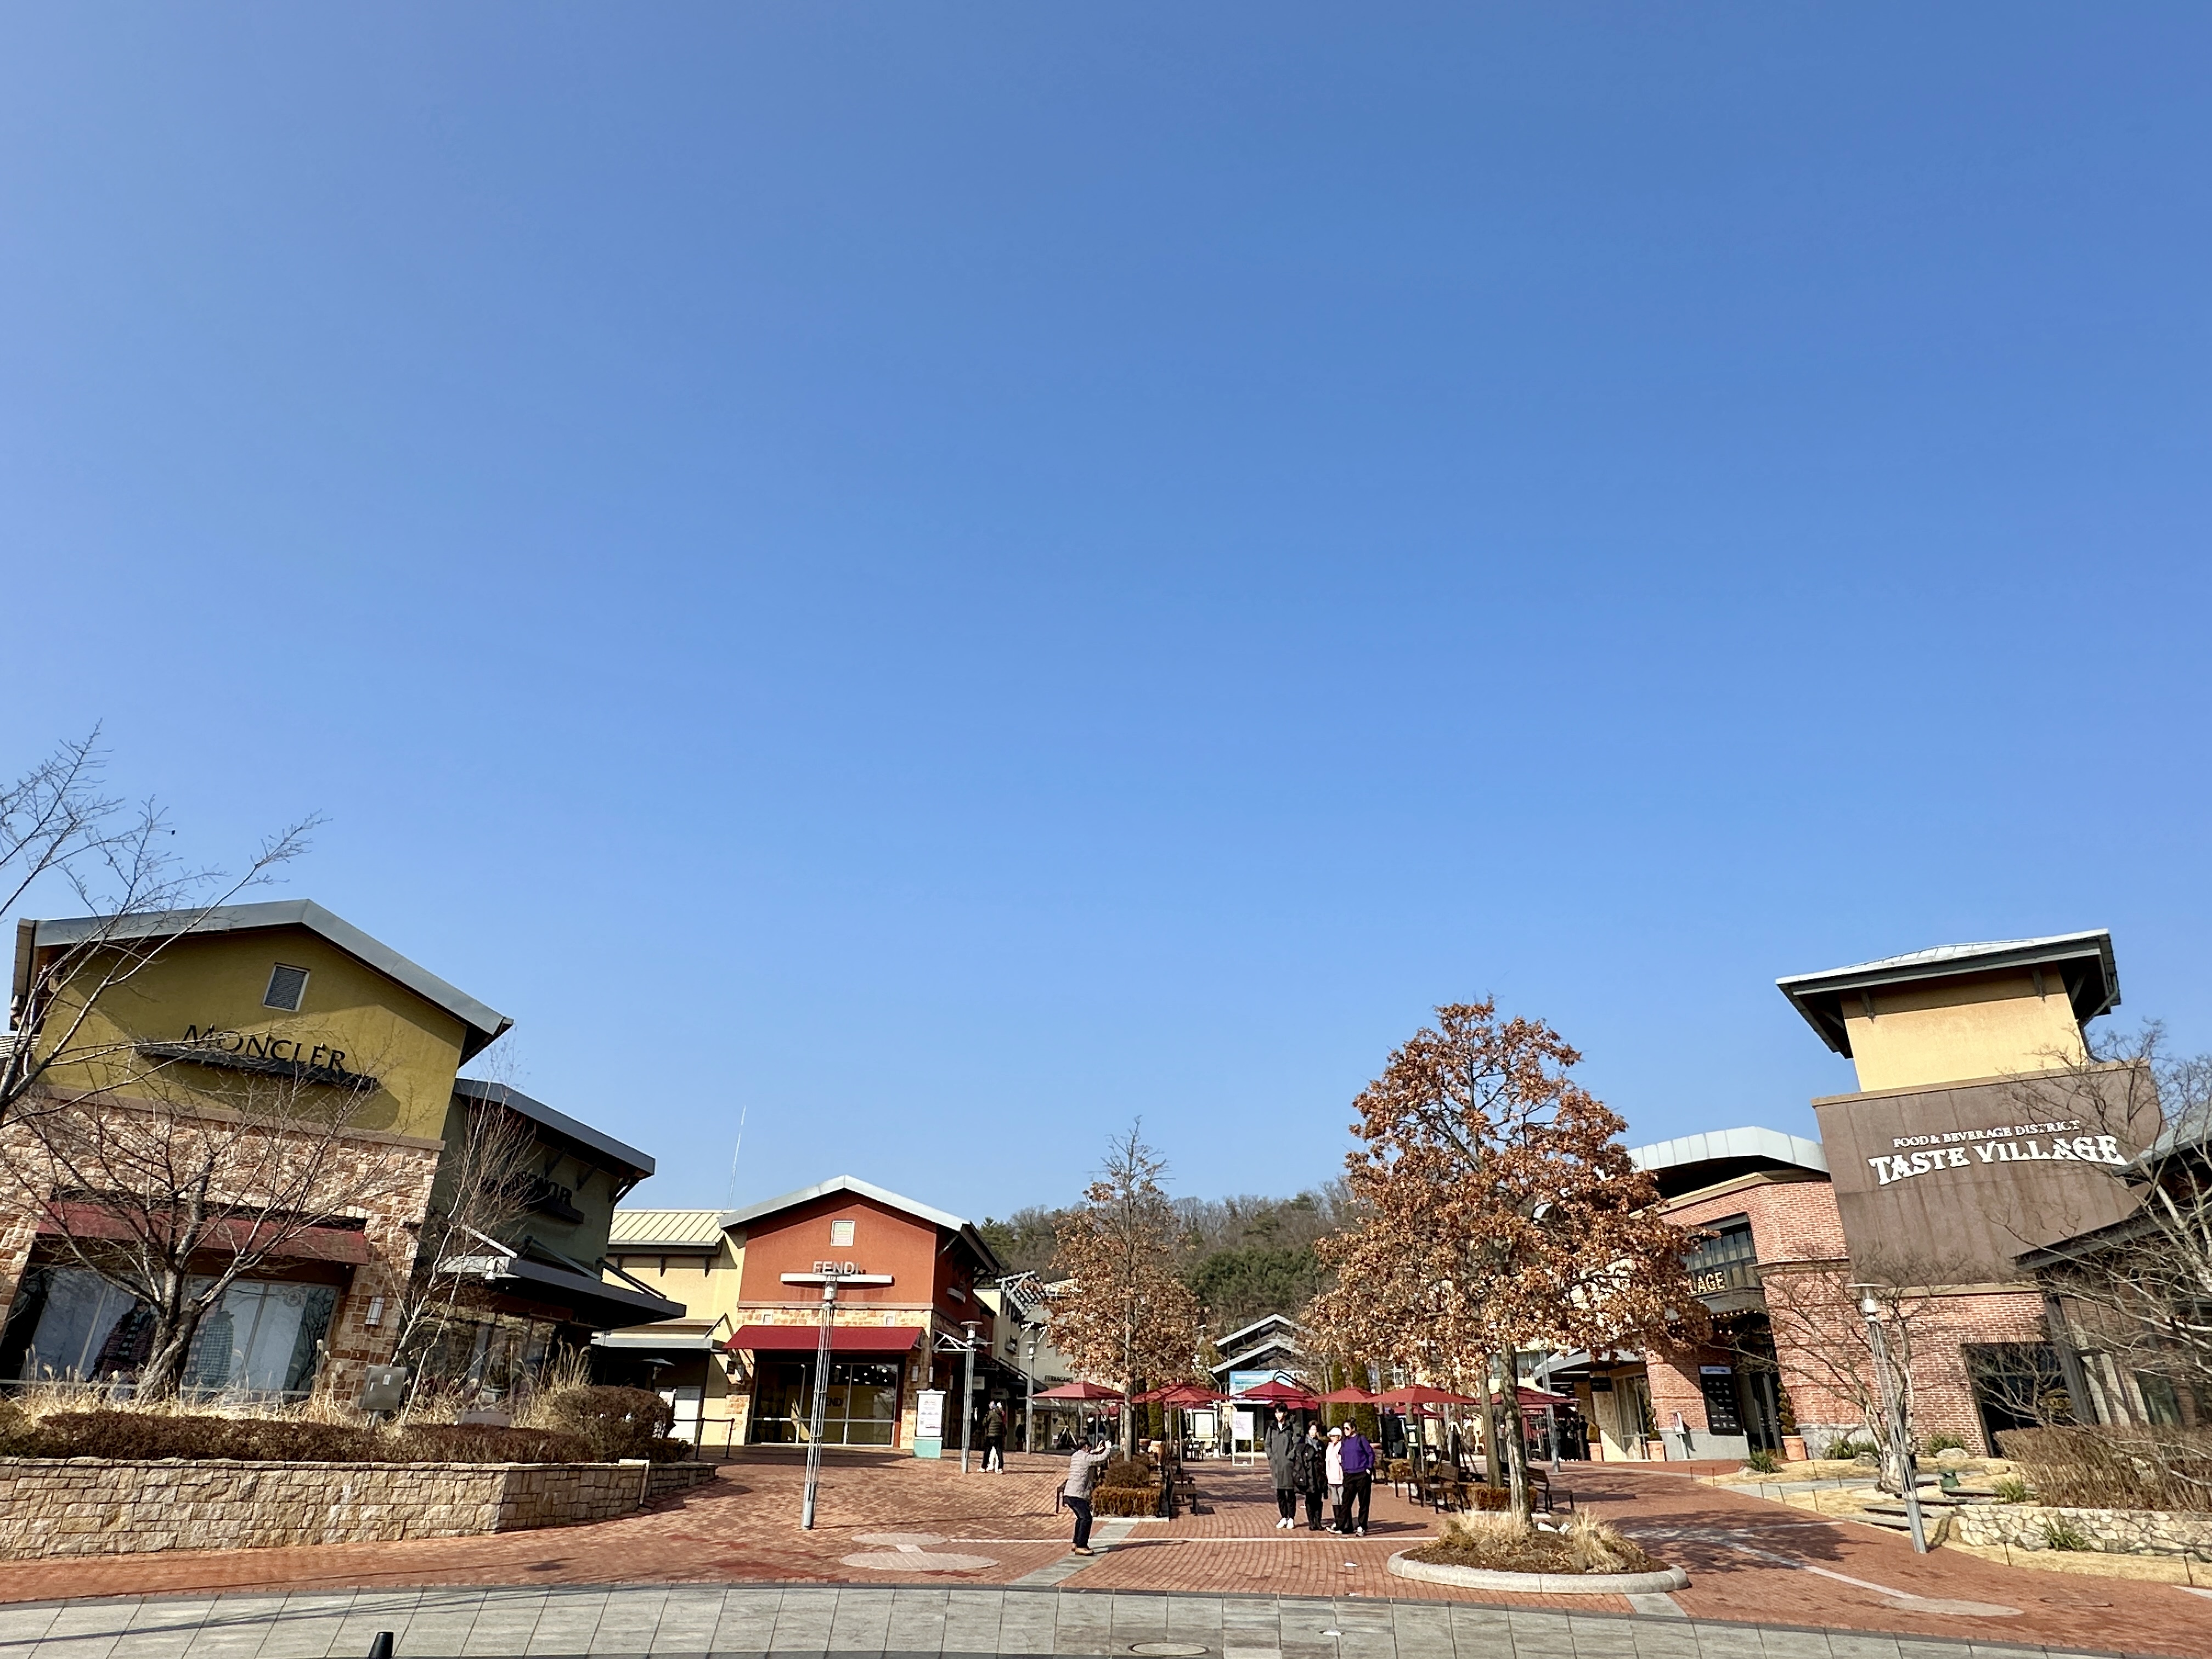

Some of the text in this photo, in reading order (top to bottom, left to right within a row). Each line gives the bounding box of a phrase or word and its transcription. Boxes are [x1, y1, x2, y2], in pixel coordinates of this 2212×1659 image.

[182, 1023, 347, 1074] MONCLER
[1893, 1120, 2081, 1148] FOOD & BEVERAGE DISTRICT
[1868, 1135, 2128, 1185] TASTE VILLAGE
[812, 1261, 861, 1275] FENDI
[1688, 1272, 1725, 1295] LAGE
